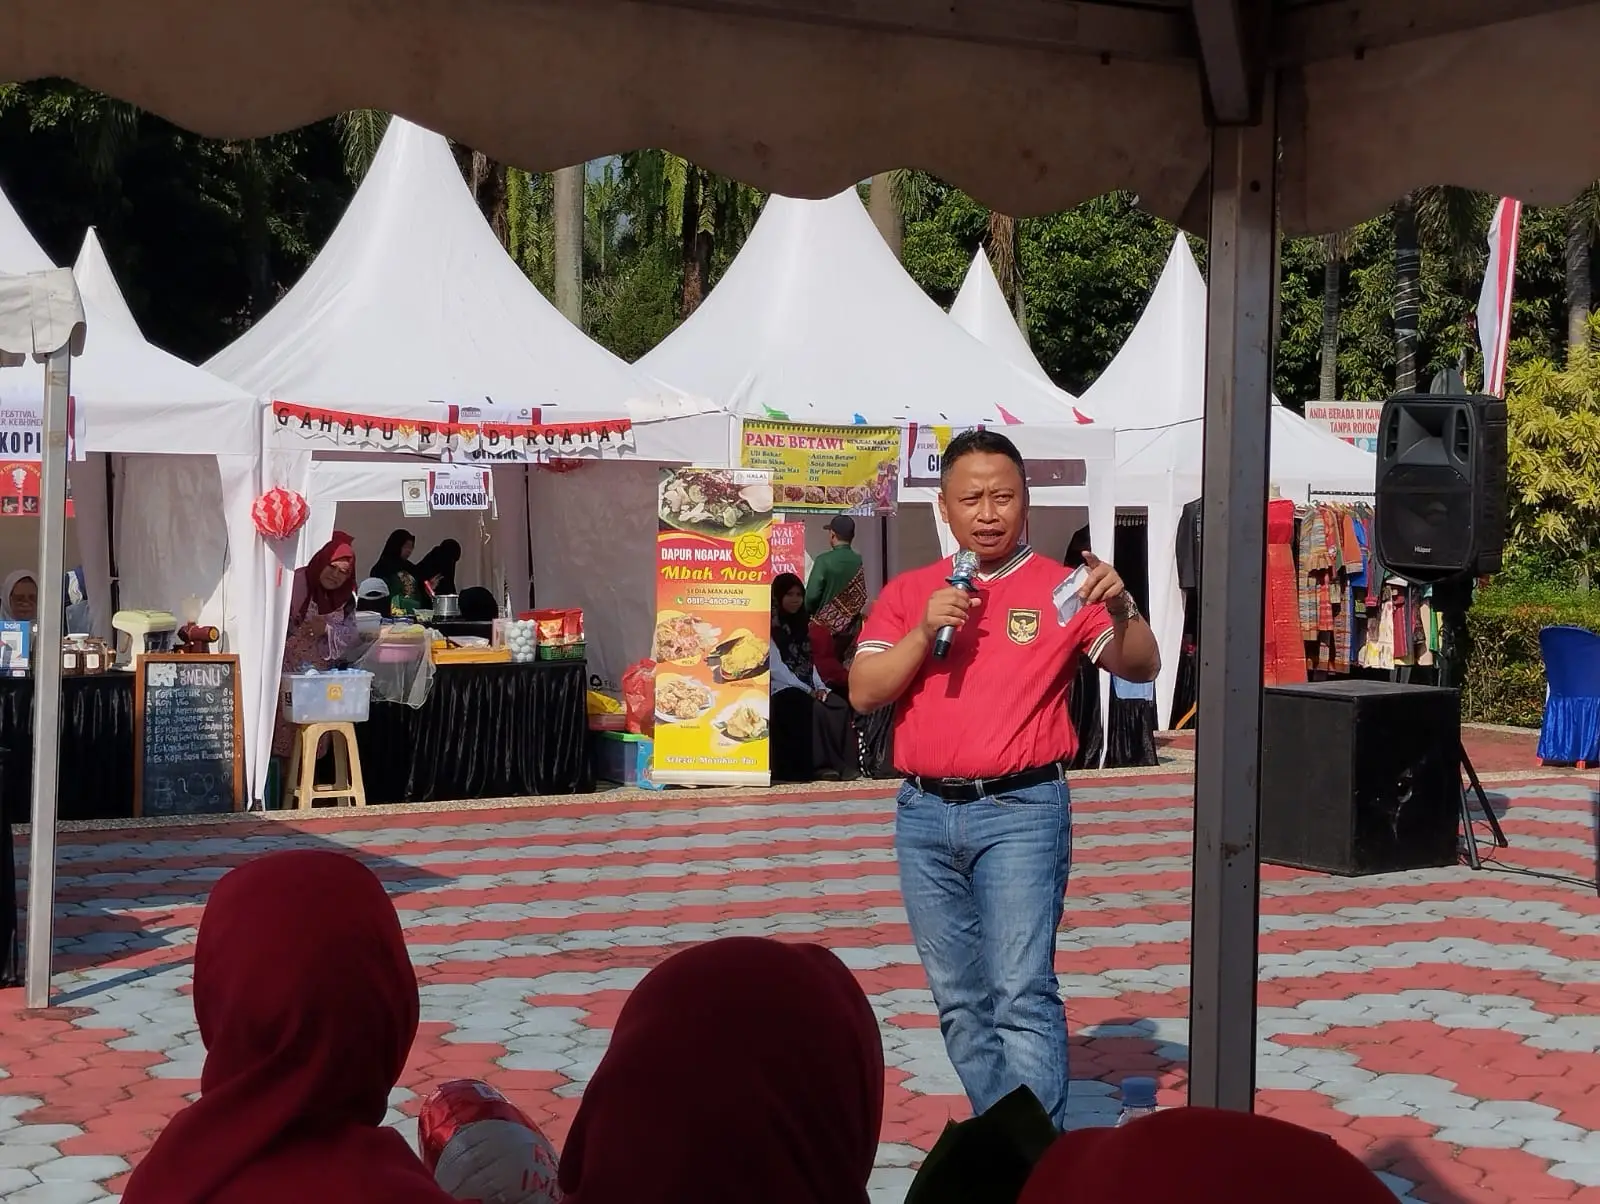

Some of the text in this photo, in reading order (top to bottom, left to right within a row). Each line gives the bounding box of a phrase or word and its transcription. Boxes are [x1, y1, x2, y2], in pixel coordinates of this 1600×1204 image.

[1, 410, 37, 418] FESTIVAL
[1310, 408, 1327, 419] ANDA
[1329, 408, 1354, 419] BERADA
[1357, 409, 1363, 419] DI
[1330, 422, 1377, 433] TANPA ROKOK
[489, 424, 626, 446] DIRGAHAY
[745, 433, 844, 450] PANE BETAWI
[434, 493, 486, 506] BOJONGSARI
[661, 548, 732, 561] DAPUR NGAPAK
[661, 566, 767, 581] Mbak Noer
[187, 668, 220, 686] MENU
